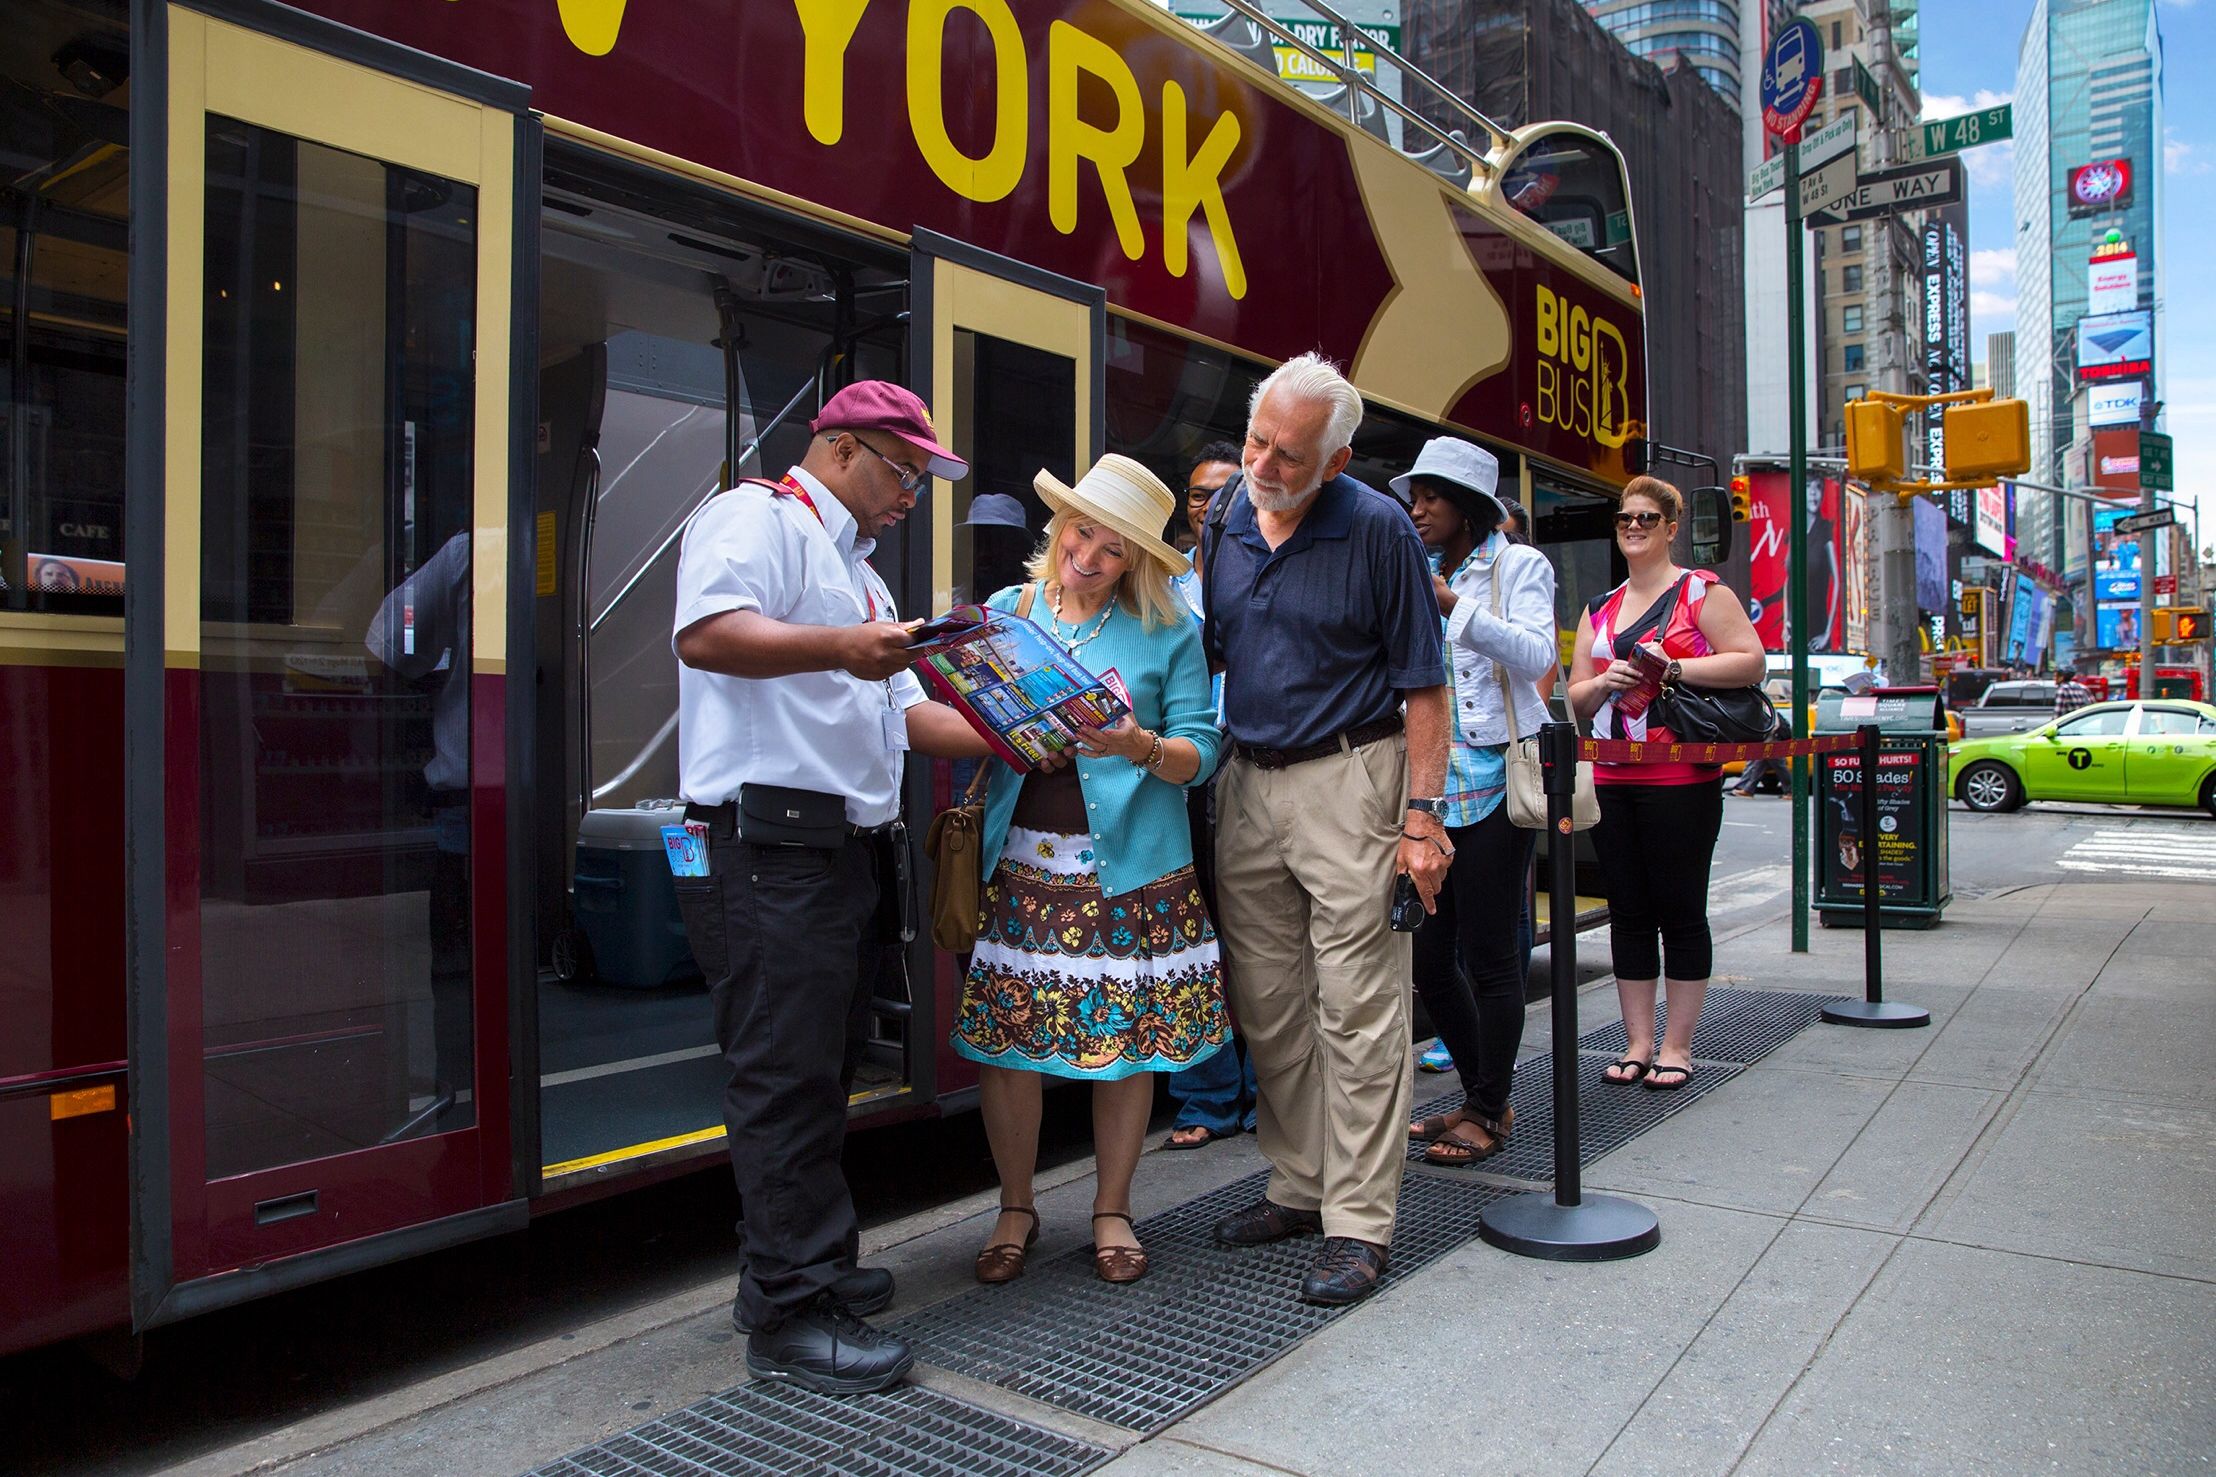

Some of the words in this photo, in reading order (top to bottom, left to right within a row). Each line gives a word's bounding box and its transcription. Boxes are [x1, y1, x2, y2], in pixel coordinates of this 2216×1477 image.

[1294, 24, 1328, 47] DRY
[1777, 84, 1816, 130] STANDING
[1931, 123, 1946, 151] W
[1955, 115, 1980, 145] 48
[1988, 109, 2005, 126] ST
[796, 0, 1248, 301] YORK
[1802, 180, 1807, 191] 7
[1808, 176, 1817, 187] Av
[1893, 174, 1941, 199] WAY
[1801, 193, 1809, 206] W
[1811, 189, 1820, 201] 48
[1821, 185, 1829, 197] St
[1926, 273, 1943, 344] EXPRESS
[1537, 283, 1591, 372] BIG
[2079, 360, 2150, 380] TOSHIBA
[1538, 359, 1591, 438] BUS
[2106, 397, 2137, 409] TDK
[60, 523, 110, 539] CAFE
[1020, 740, 1044, 762] Free!
[1834, 758, 1847, 767] SO
[1879, 755, 1912, 765] HURTS!
[1833, 769, 1854, 784] 50
[1856, 770, 1914, 785] Sades!
[668, 837, 682, 850] BIG
